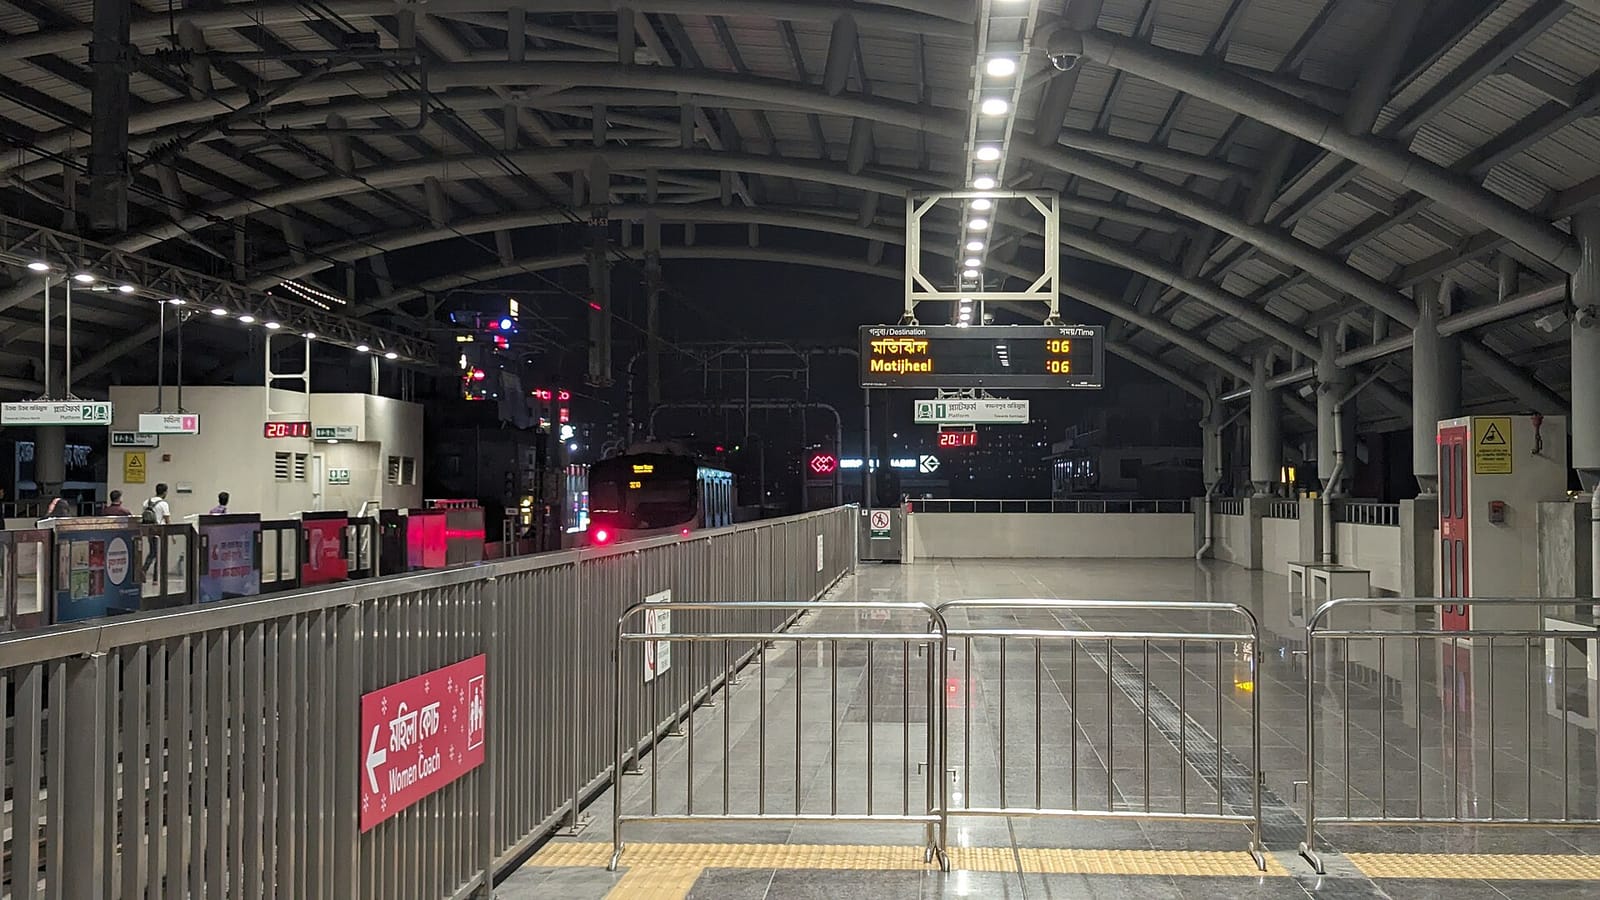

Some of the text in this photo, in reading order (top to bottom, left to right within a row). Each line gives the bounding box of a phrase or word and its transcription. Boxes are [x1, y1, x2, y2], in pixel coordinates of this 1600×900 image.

[871, 338, 928, 355] মতিঝিল
[870, 358, 932, 375] Motijheel
[83, 406, 91, 419] 2
[937, 405, 943, 417] 1
[267, 424, 306, 437] 20:11
[940, 434, 975, 446] 20:11
[389, 701, 441, 752] মহিলা কোচ
[389, 747, 441, 795] Women Coach
